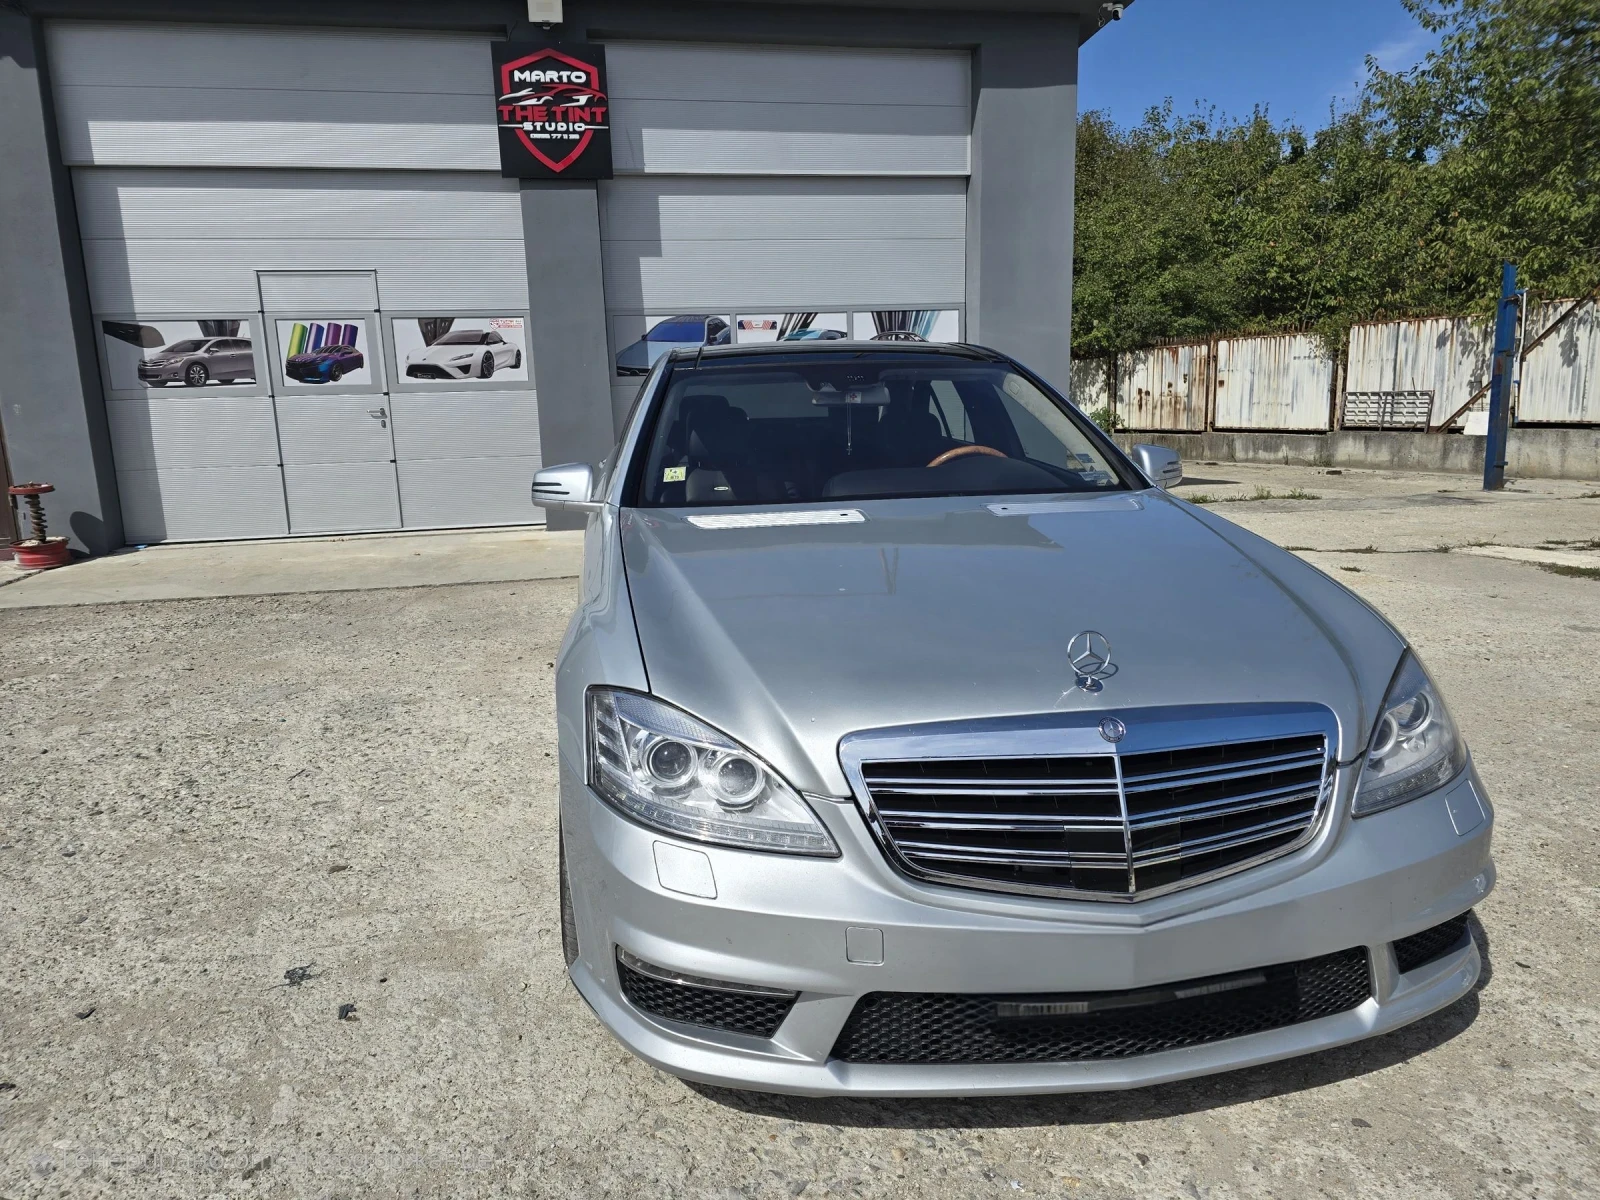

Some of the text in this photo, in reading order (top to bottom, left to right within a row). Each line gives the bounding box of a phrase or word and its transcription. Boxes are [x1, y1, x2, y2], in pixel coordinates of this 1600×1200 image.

[514, 70, 587, 83] MARTO
[498, 105, 607, 123] THE TINT
[522, 122, 586, 132] STUDIO
